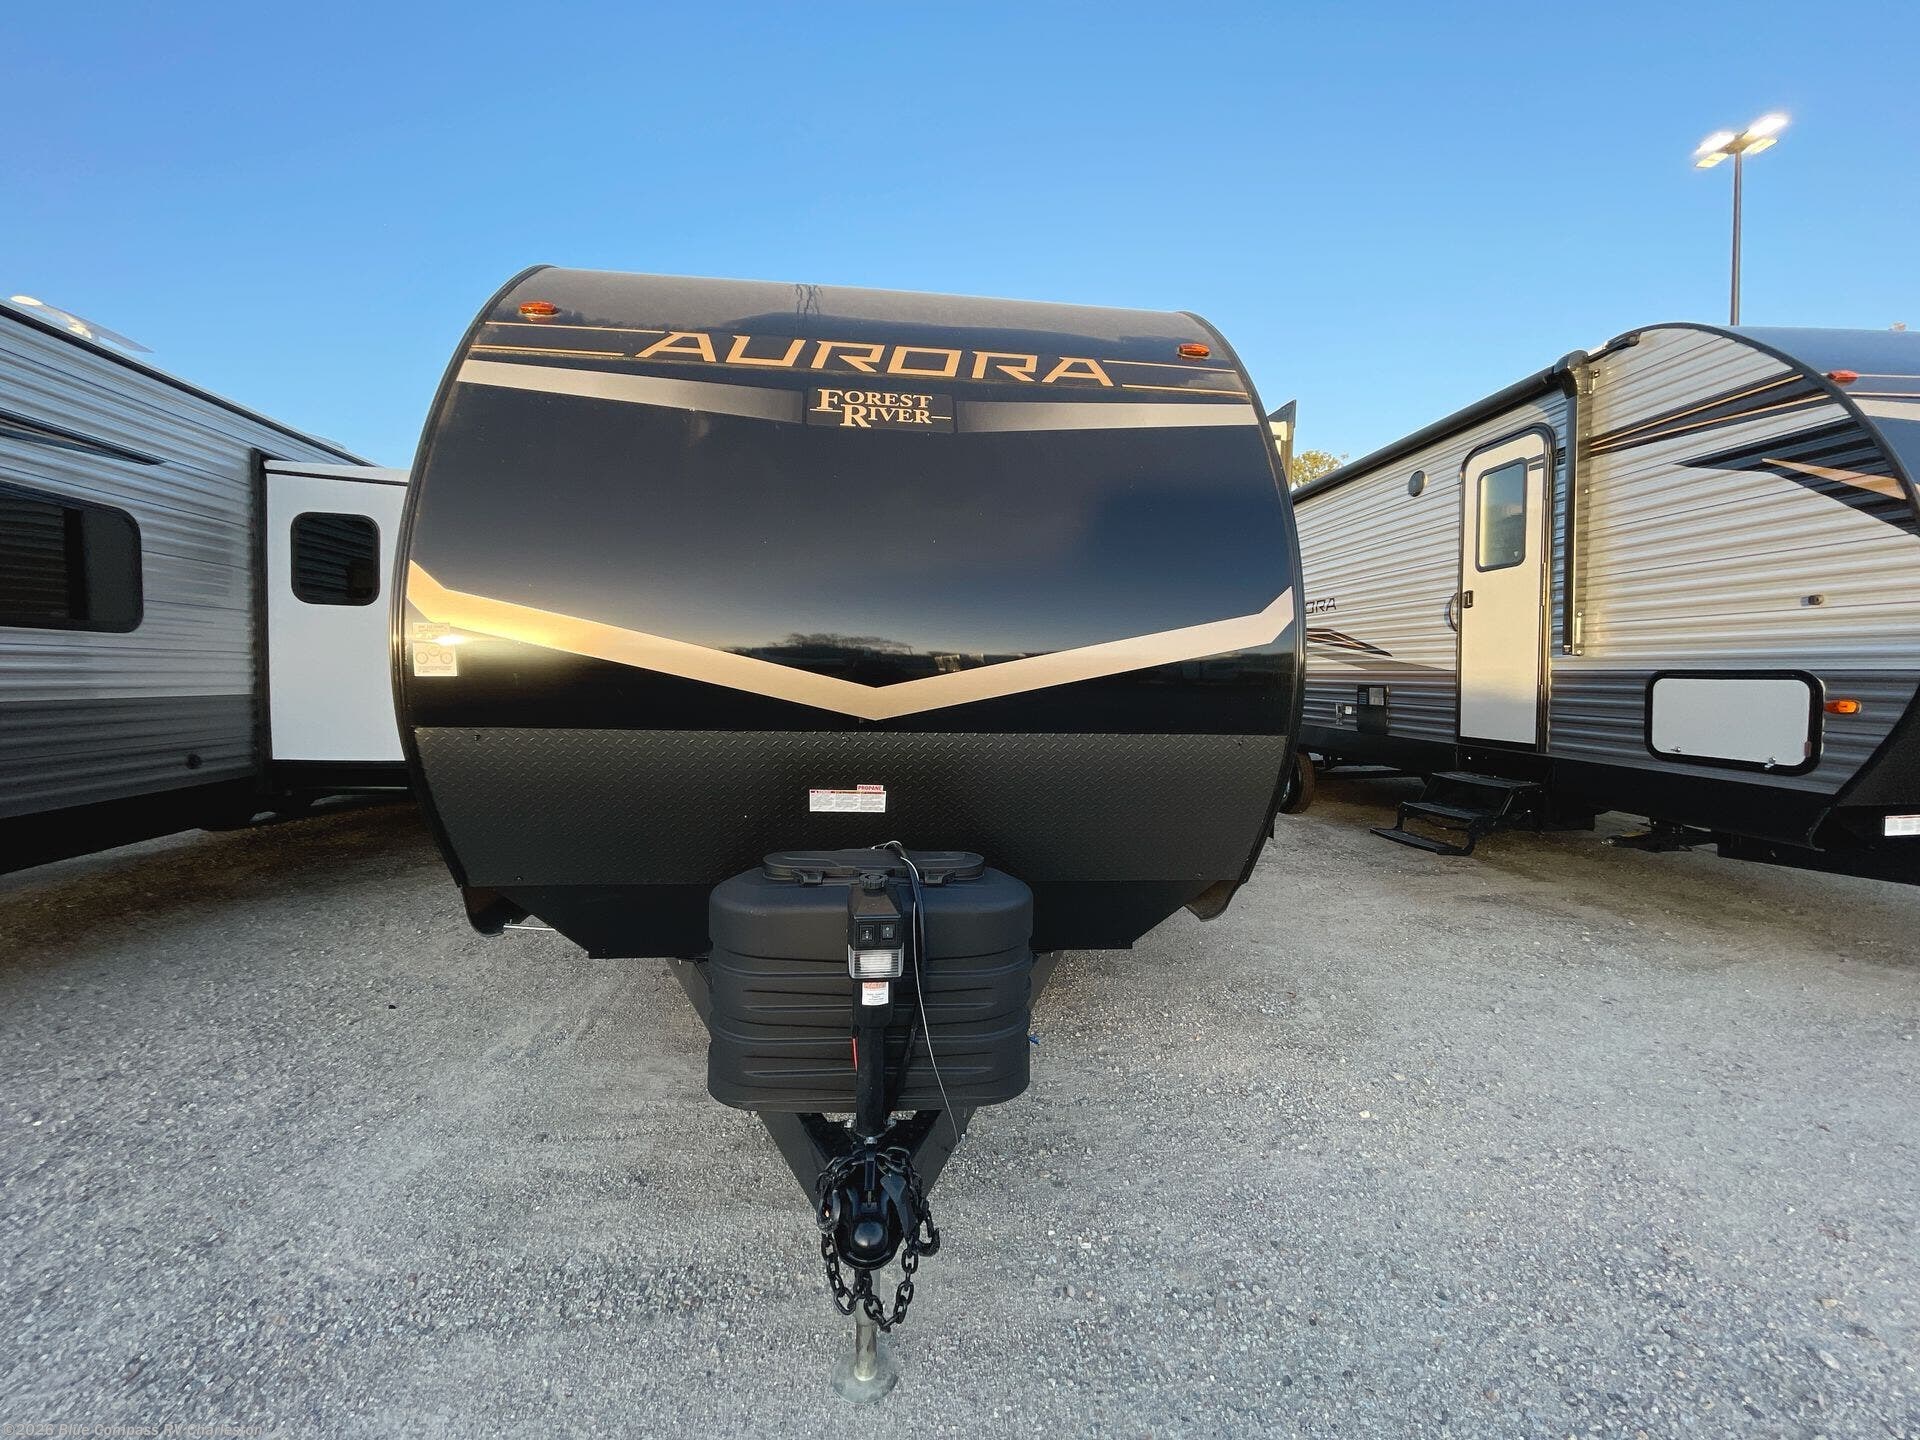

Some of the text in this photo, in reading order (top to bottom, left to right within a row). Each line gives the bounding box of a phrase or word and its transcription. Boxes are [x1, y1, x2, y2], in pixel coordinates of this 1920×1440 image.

[634, 330, 1115, 388] AURORA
[817, 388, 933, 411] FOREST
[840, 404, 933, 428] RIVER
